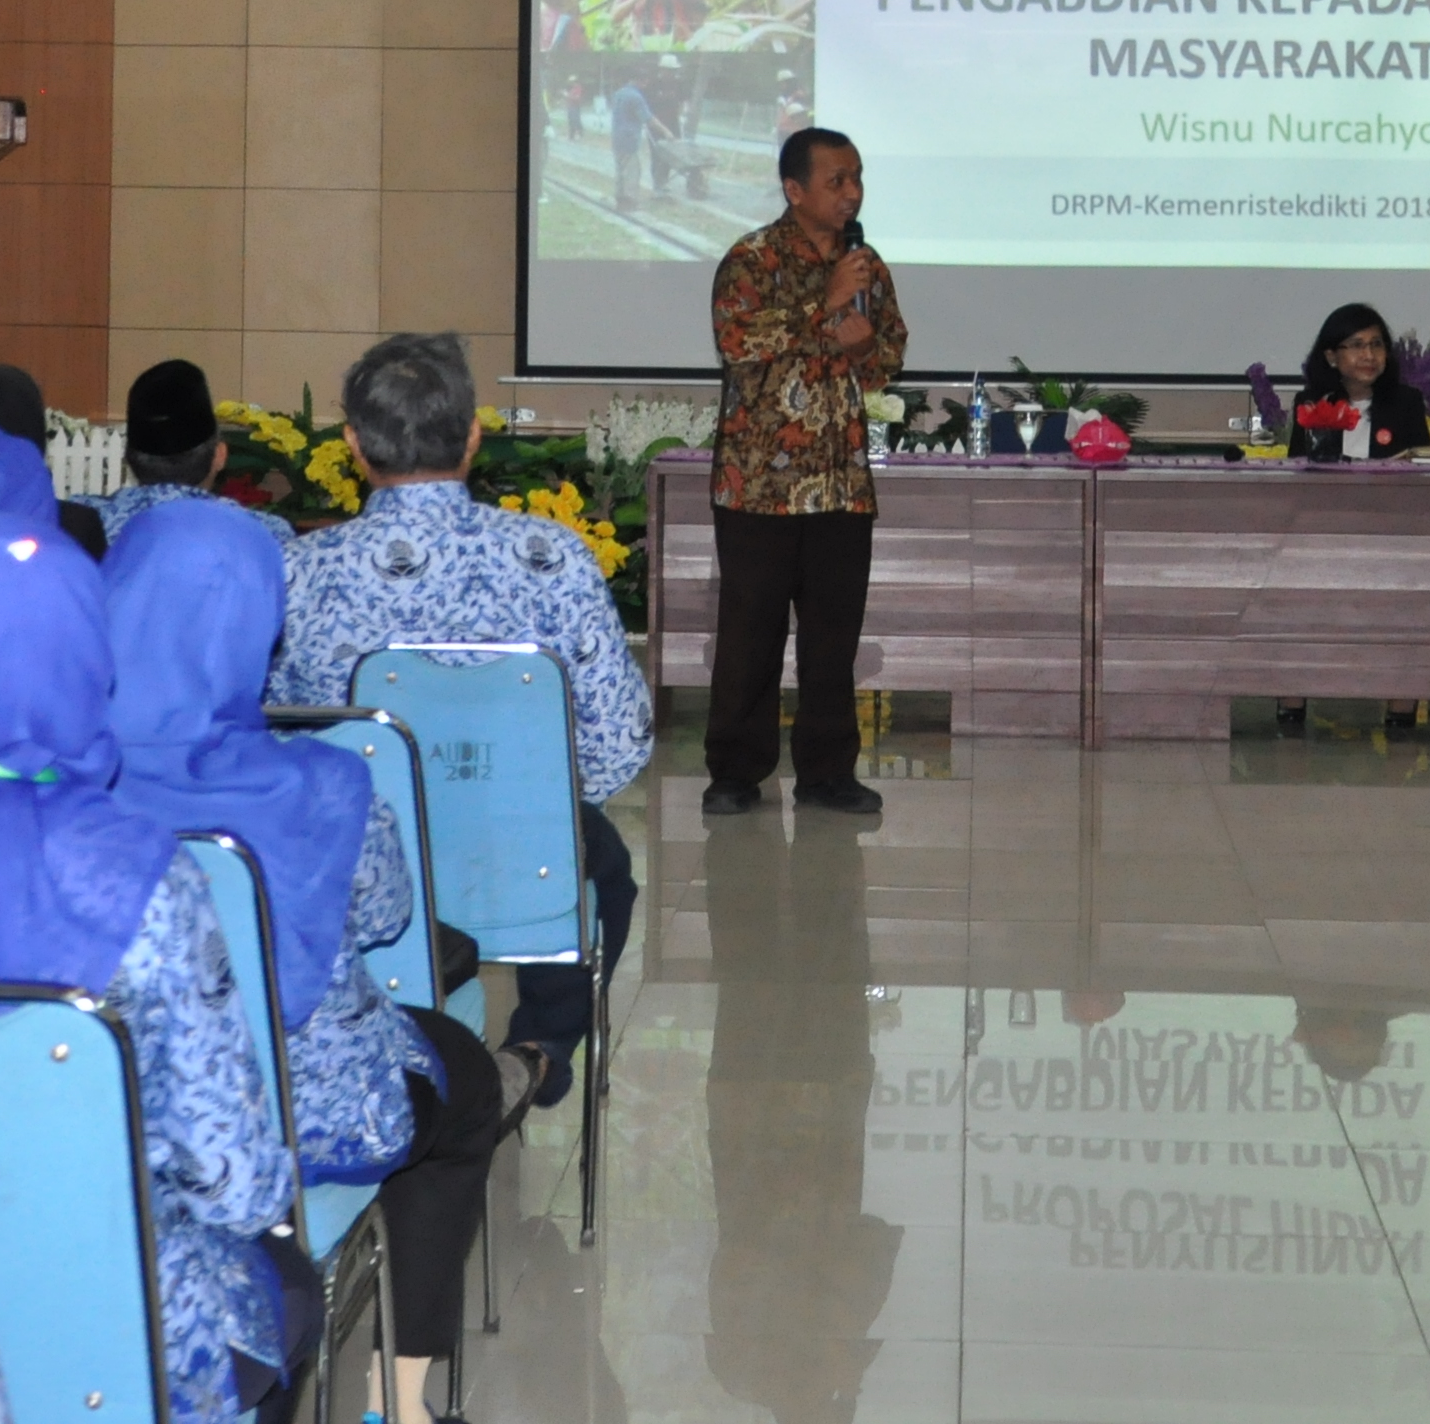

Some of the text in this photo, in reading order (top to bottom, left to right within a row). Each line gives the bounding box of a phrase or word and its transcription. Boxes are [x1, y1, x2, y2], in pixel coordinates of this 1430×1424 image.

[1139, 111, 1253, 145] Wisnu
[1050, 192, 1367, 219] DRPM-Kemenristekdikti
[429, 741, 497, 764] AUDIT
[444, 764, 493, 782] 2012
